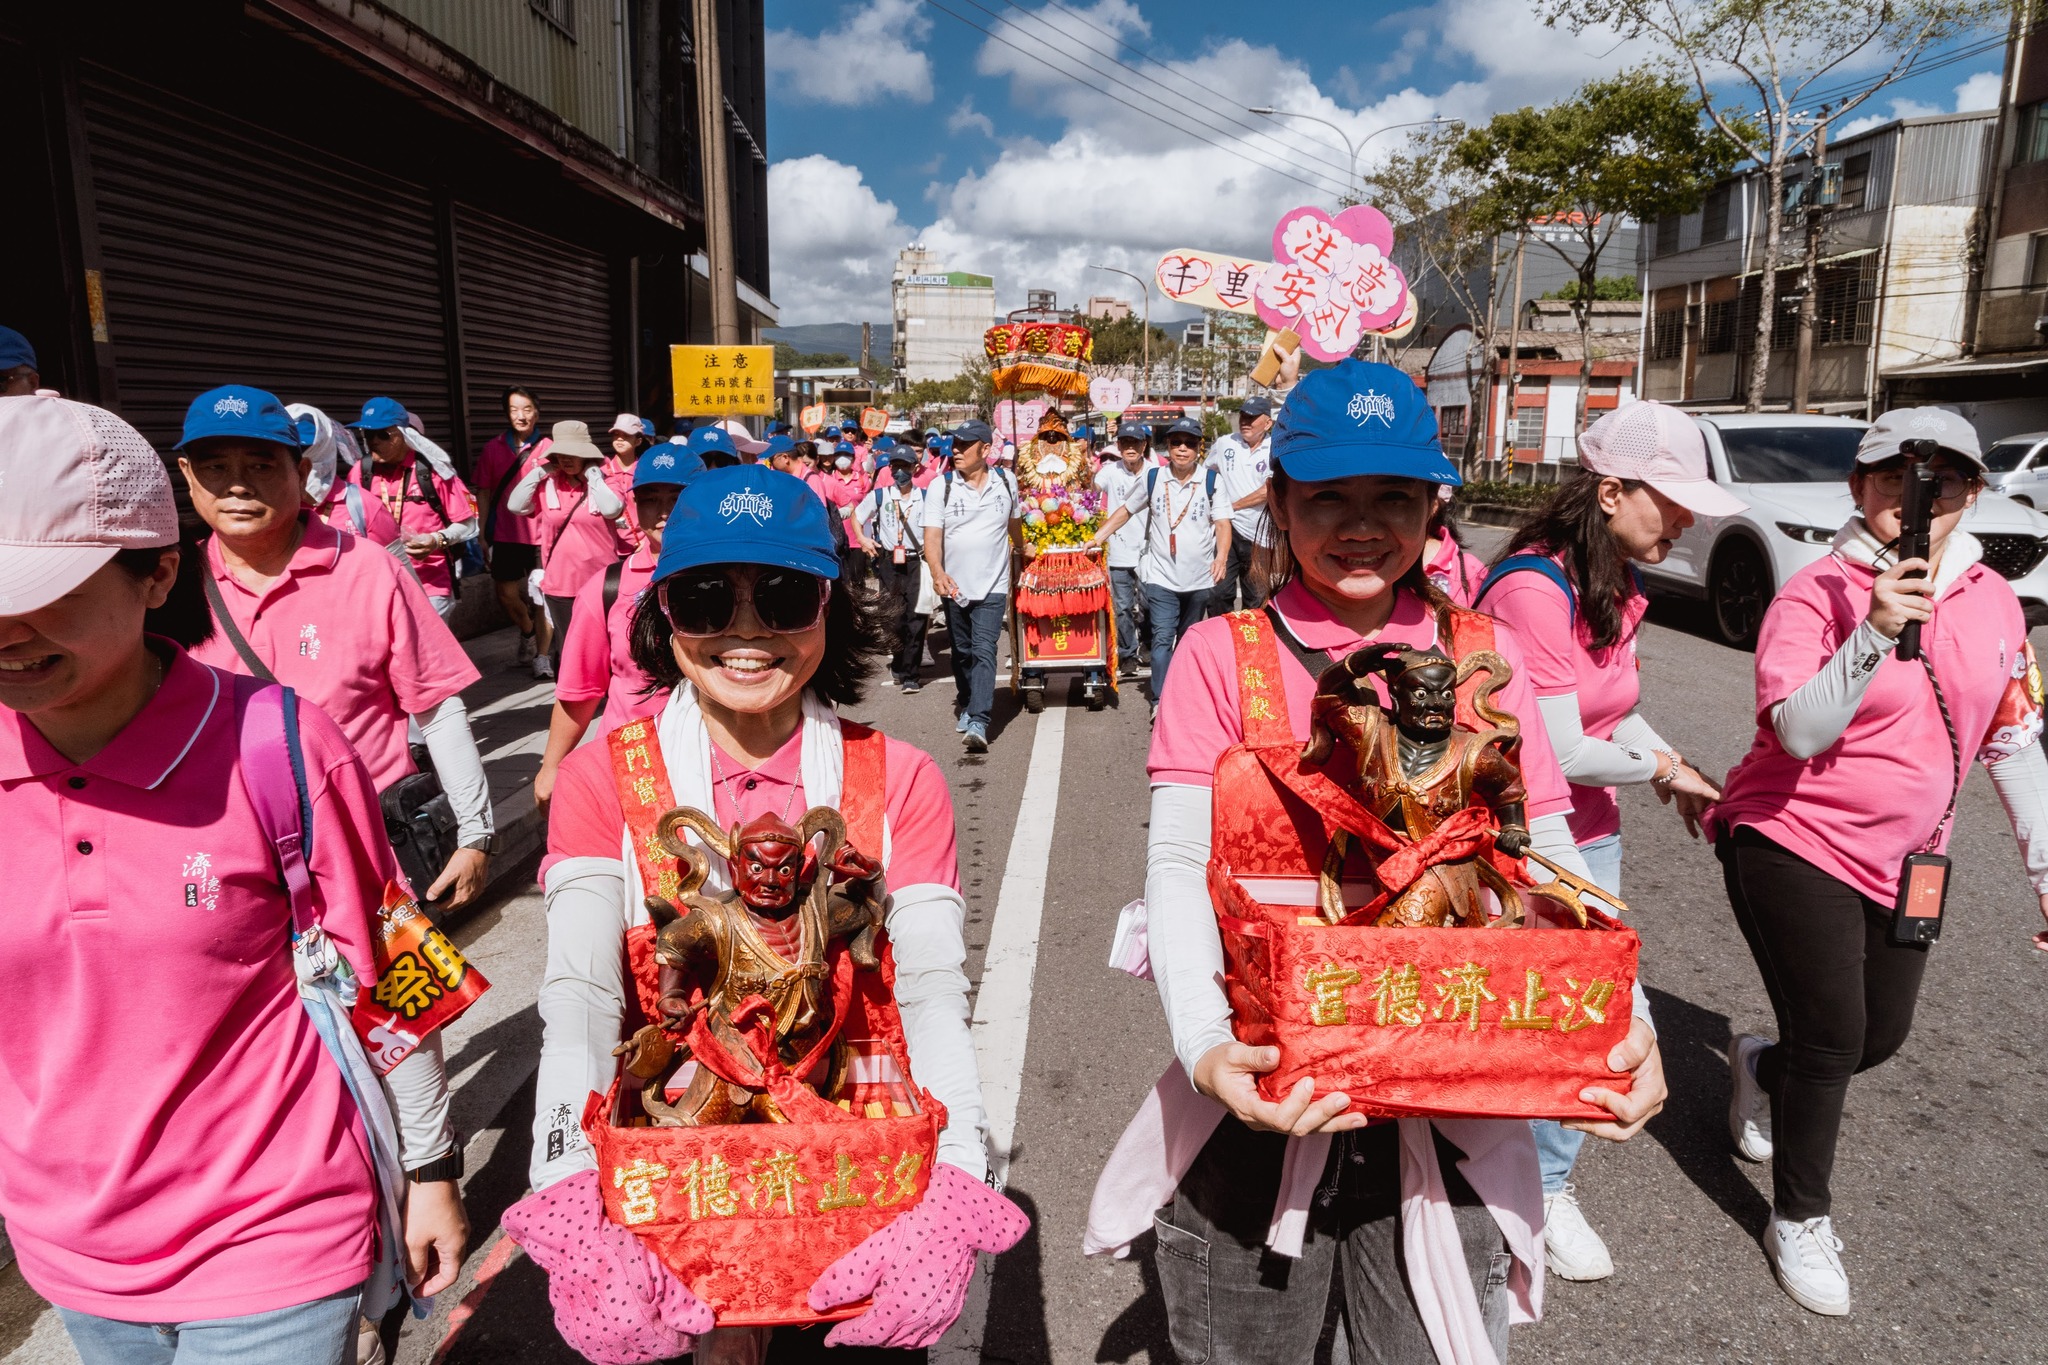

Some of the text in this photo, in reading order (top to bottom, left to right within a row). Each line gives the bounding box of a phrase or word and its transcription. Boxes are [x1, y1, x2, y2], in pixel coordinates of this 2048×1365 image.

[704, 353, 749, 369] 注意
[701, 377, 754, 389] 差兩號者
[690, 394, 766, 406] 先來排隊準備
[1114, 394, 1120, 405] 1
[1026, 416, 1035, 429] 2
[182, 852, 221, 911] 濟德宮
